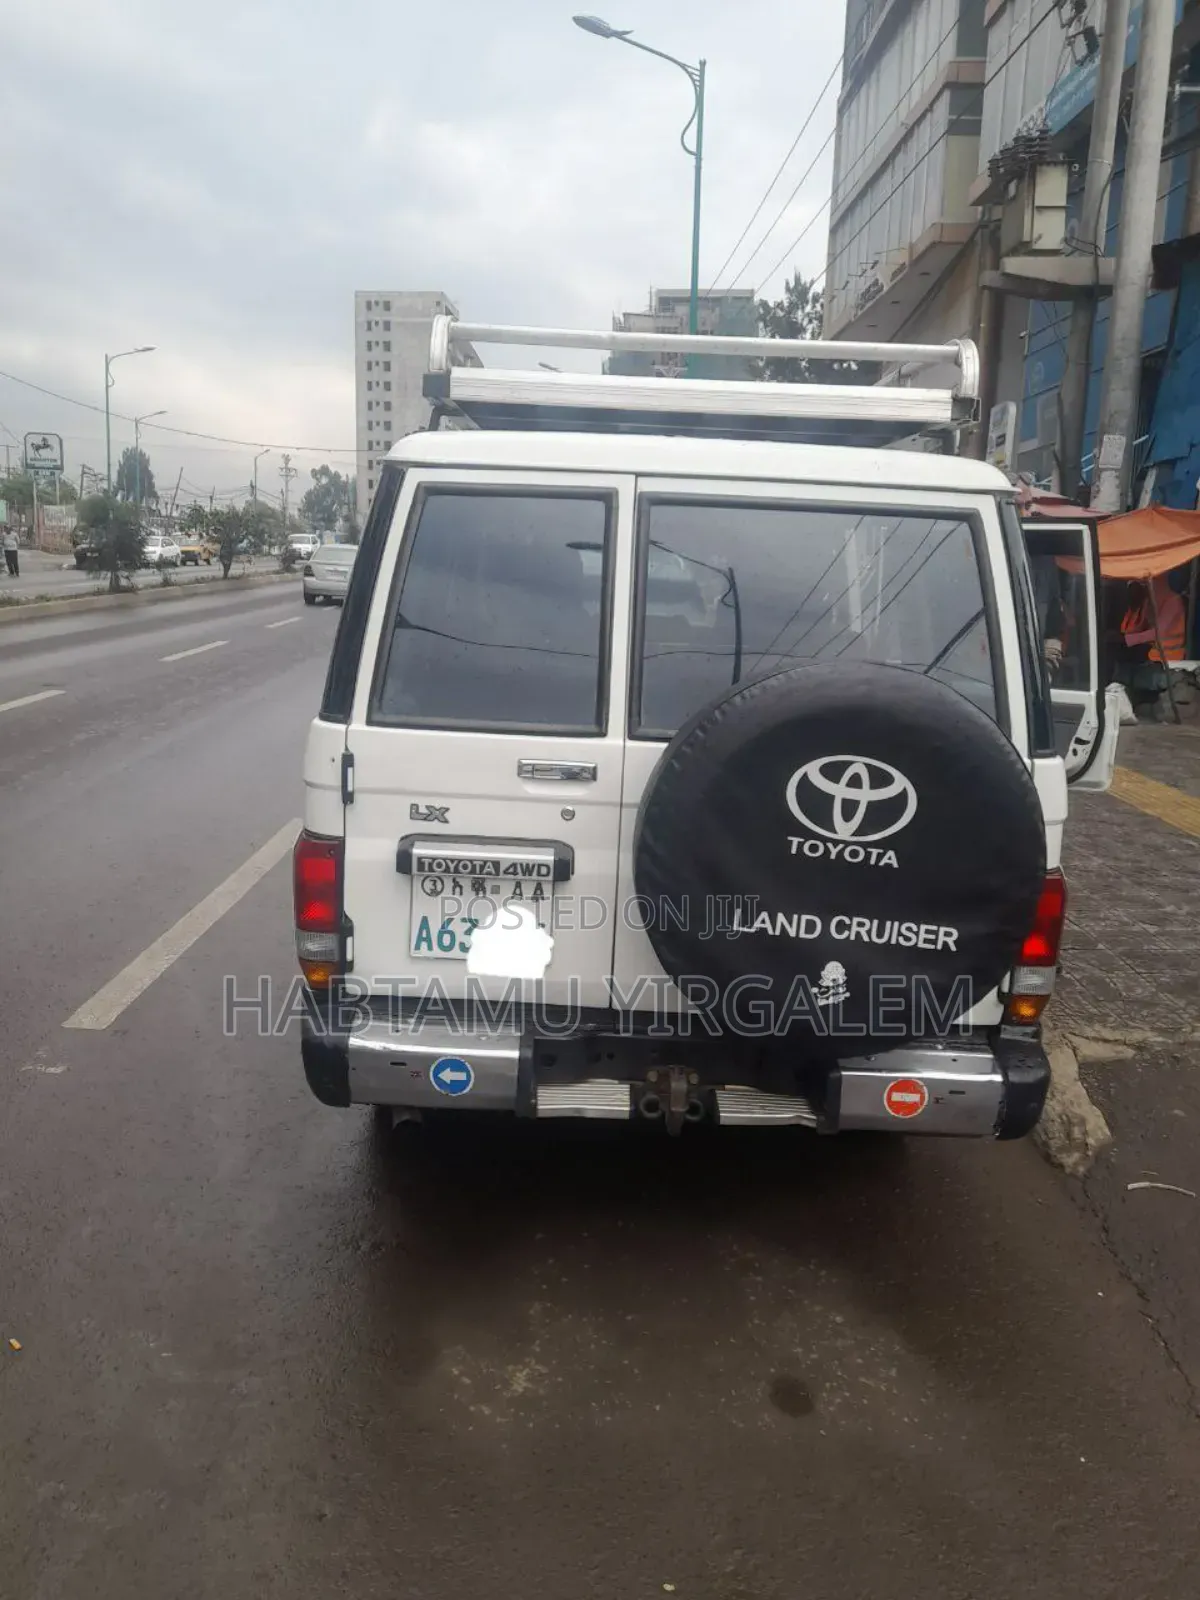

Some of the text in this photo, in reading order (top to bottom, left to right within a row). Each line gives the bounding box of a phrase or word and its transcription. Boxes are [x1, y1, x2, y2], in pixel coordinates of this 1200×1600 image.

[410, 804, 450, 824] LX
[787, 836, 899, 868] TOYOTA
[421, 858, 550, 878] TOYOTA 4WD
[733, 909, 959, 952] LAND CRUISER
